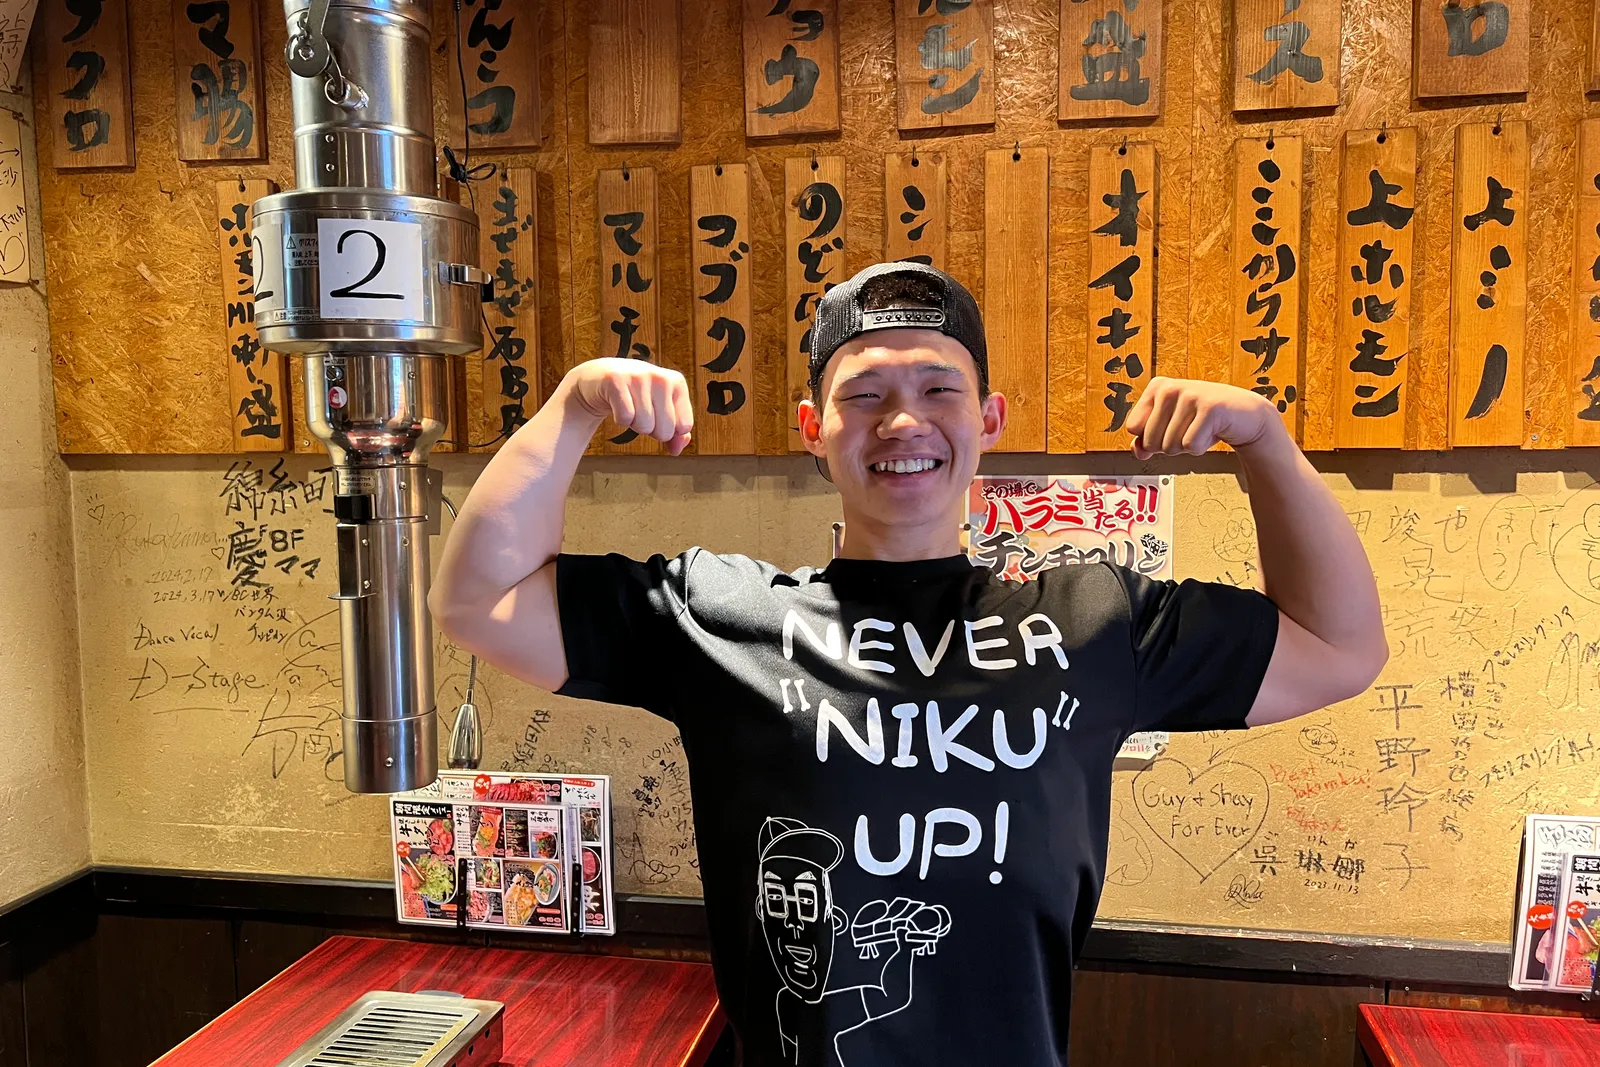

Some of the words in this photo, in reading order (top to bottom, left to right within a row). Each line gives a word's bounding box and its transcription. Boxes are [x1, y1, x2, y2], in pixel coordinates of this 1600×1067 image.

[329, 228, 406, 301] 2
[1346, 168, 1416, 418] 上ホルモン
[1462, 175, 1517, 421] 上ミノ
[697, 213, 750, 416] コブクロ
[982, 481, 1037, 500] その場で
[274, 555, 322, 580] ママ
[782, 607, 1070, 677] NEVER
[1142, 781, 1186, 812] Guy
[1209, 782, 1254, 809] Shay
[1171, 815, 1205, 838] For
[1214, 817, 1250, 837] Ever
[854, 801, 1010, 885] UP!
